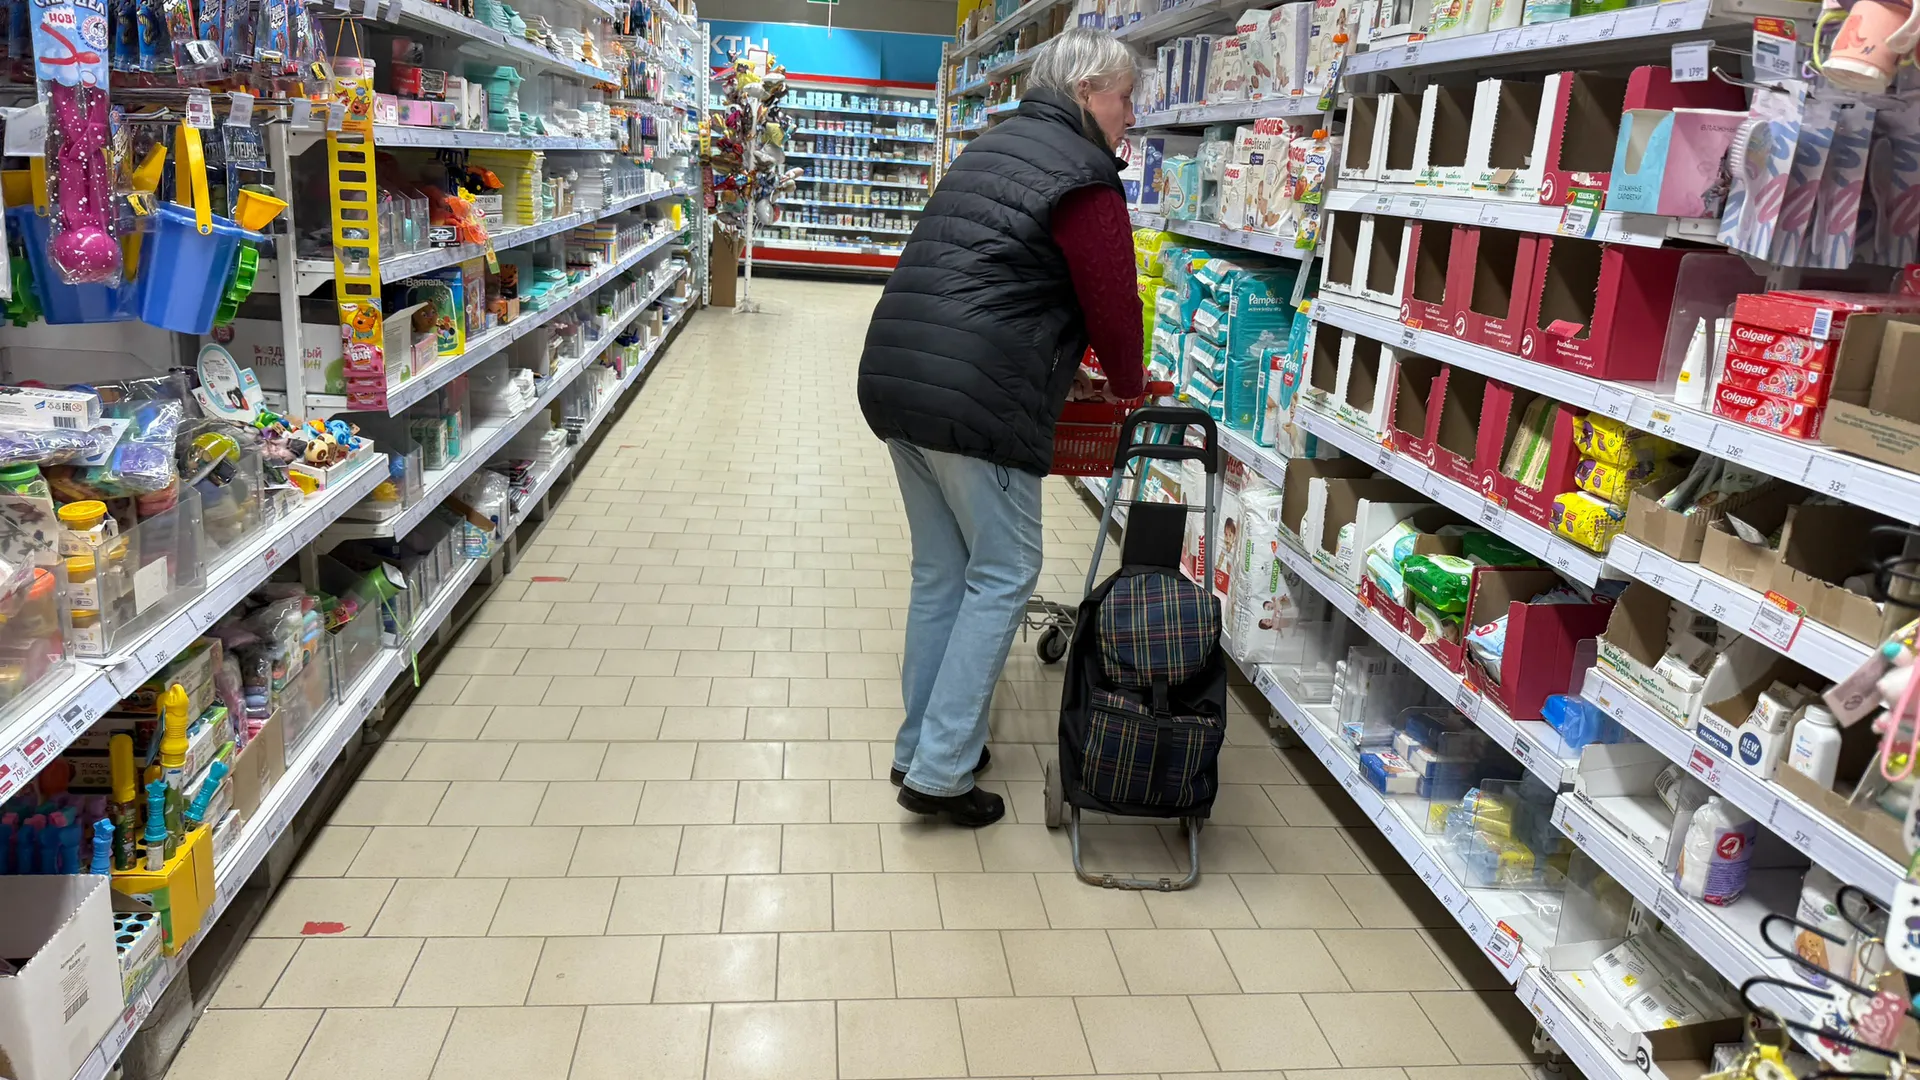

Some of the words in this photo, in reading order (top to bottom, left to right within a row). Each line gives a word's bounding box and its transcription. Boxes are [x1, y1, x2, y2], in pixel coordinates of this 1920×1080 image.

[1249, 293, 1284, 306] Pampers
[1736, 327, 1774, 344] Colgate
[1730, 359, 1768, 375] Colgate
[1721, 389, 1756, 406] Colgate
[1811, 412, 1820, 438] Colgate
[1703, 714, 1722, 734] PERFECT
[1722, 726, 1732, 737] FIT
[1700, 729, 1728, 751] ЛАКОМСТВО
[1741, 737, 1760, 753] NEW
